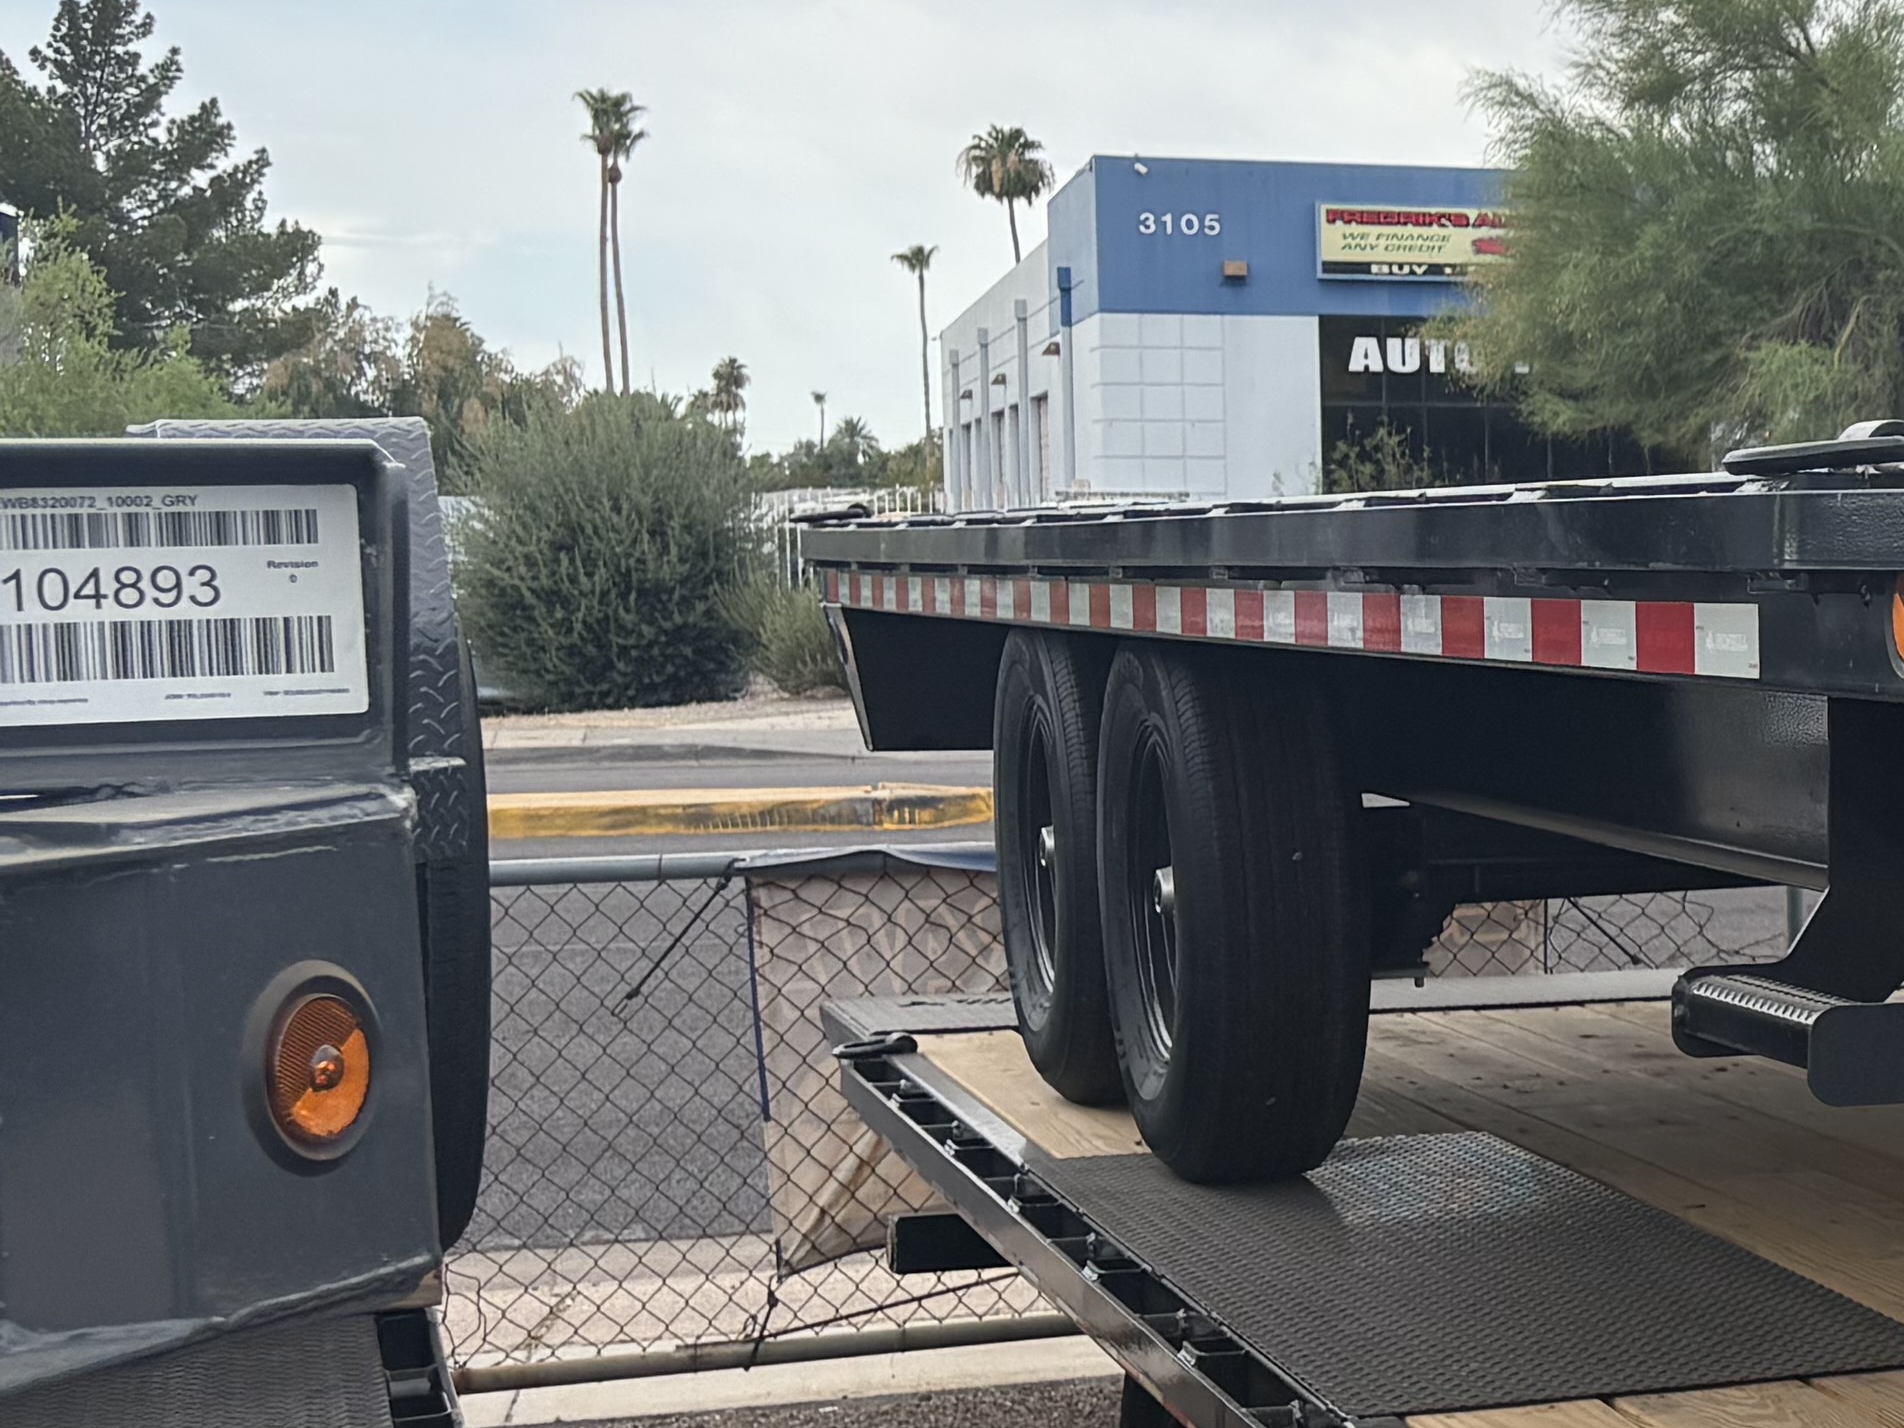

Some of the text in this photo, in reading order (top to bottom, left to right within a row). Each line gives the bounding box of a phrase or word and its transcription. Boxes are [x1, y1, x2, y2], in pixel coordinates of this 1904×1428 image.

[1138, 211, 1221, 236] 3105
[1375, 232, 1452, 244] FINANCE
[1340, 242, 1447, 254] ANY CREDIT
[1370, 263, 1429, 275] BUY
[266, 560, 320, 570] Revision
[1, 564, 221, 613] 104893
